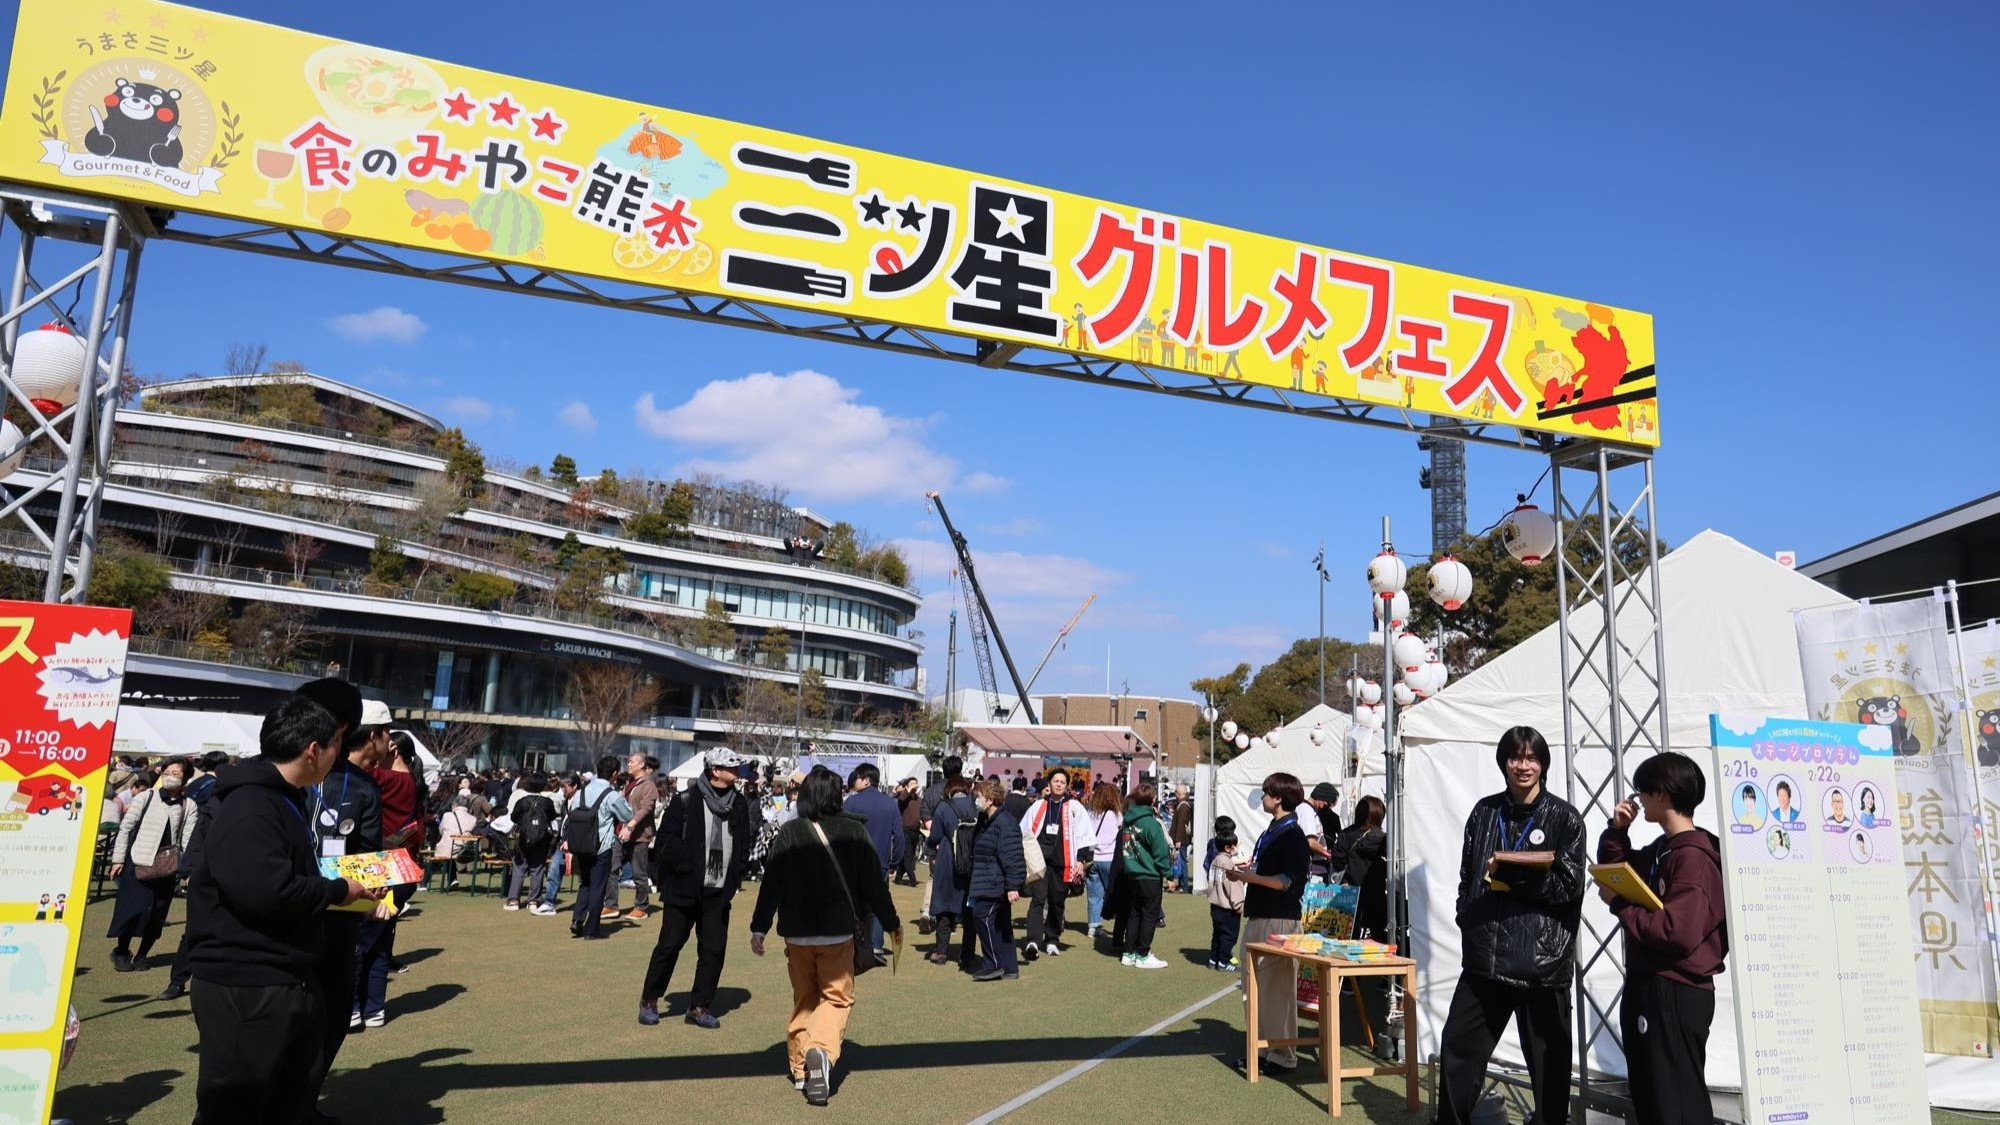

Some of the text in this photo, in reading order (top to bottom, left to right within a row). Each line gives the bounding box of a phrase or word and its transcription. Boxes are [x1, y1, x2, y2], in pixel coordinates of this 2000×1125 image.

[76, 31, 218, 82] うまさ三ツ星
[73, 159, 140, 175] Gourmet
[154, 169, 191, 190] Food
[554, 642, 587, 655] SAKURA
[15, 729, 61, 745] 11:00
[38, 746, 87, 762] 16:00
[1755, 744, 1858, 761] ステージプログラム
